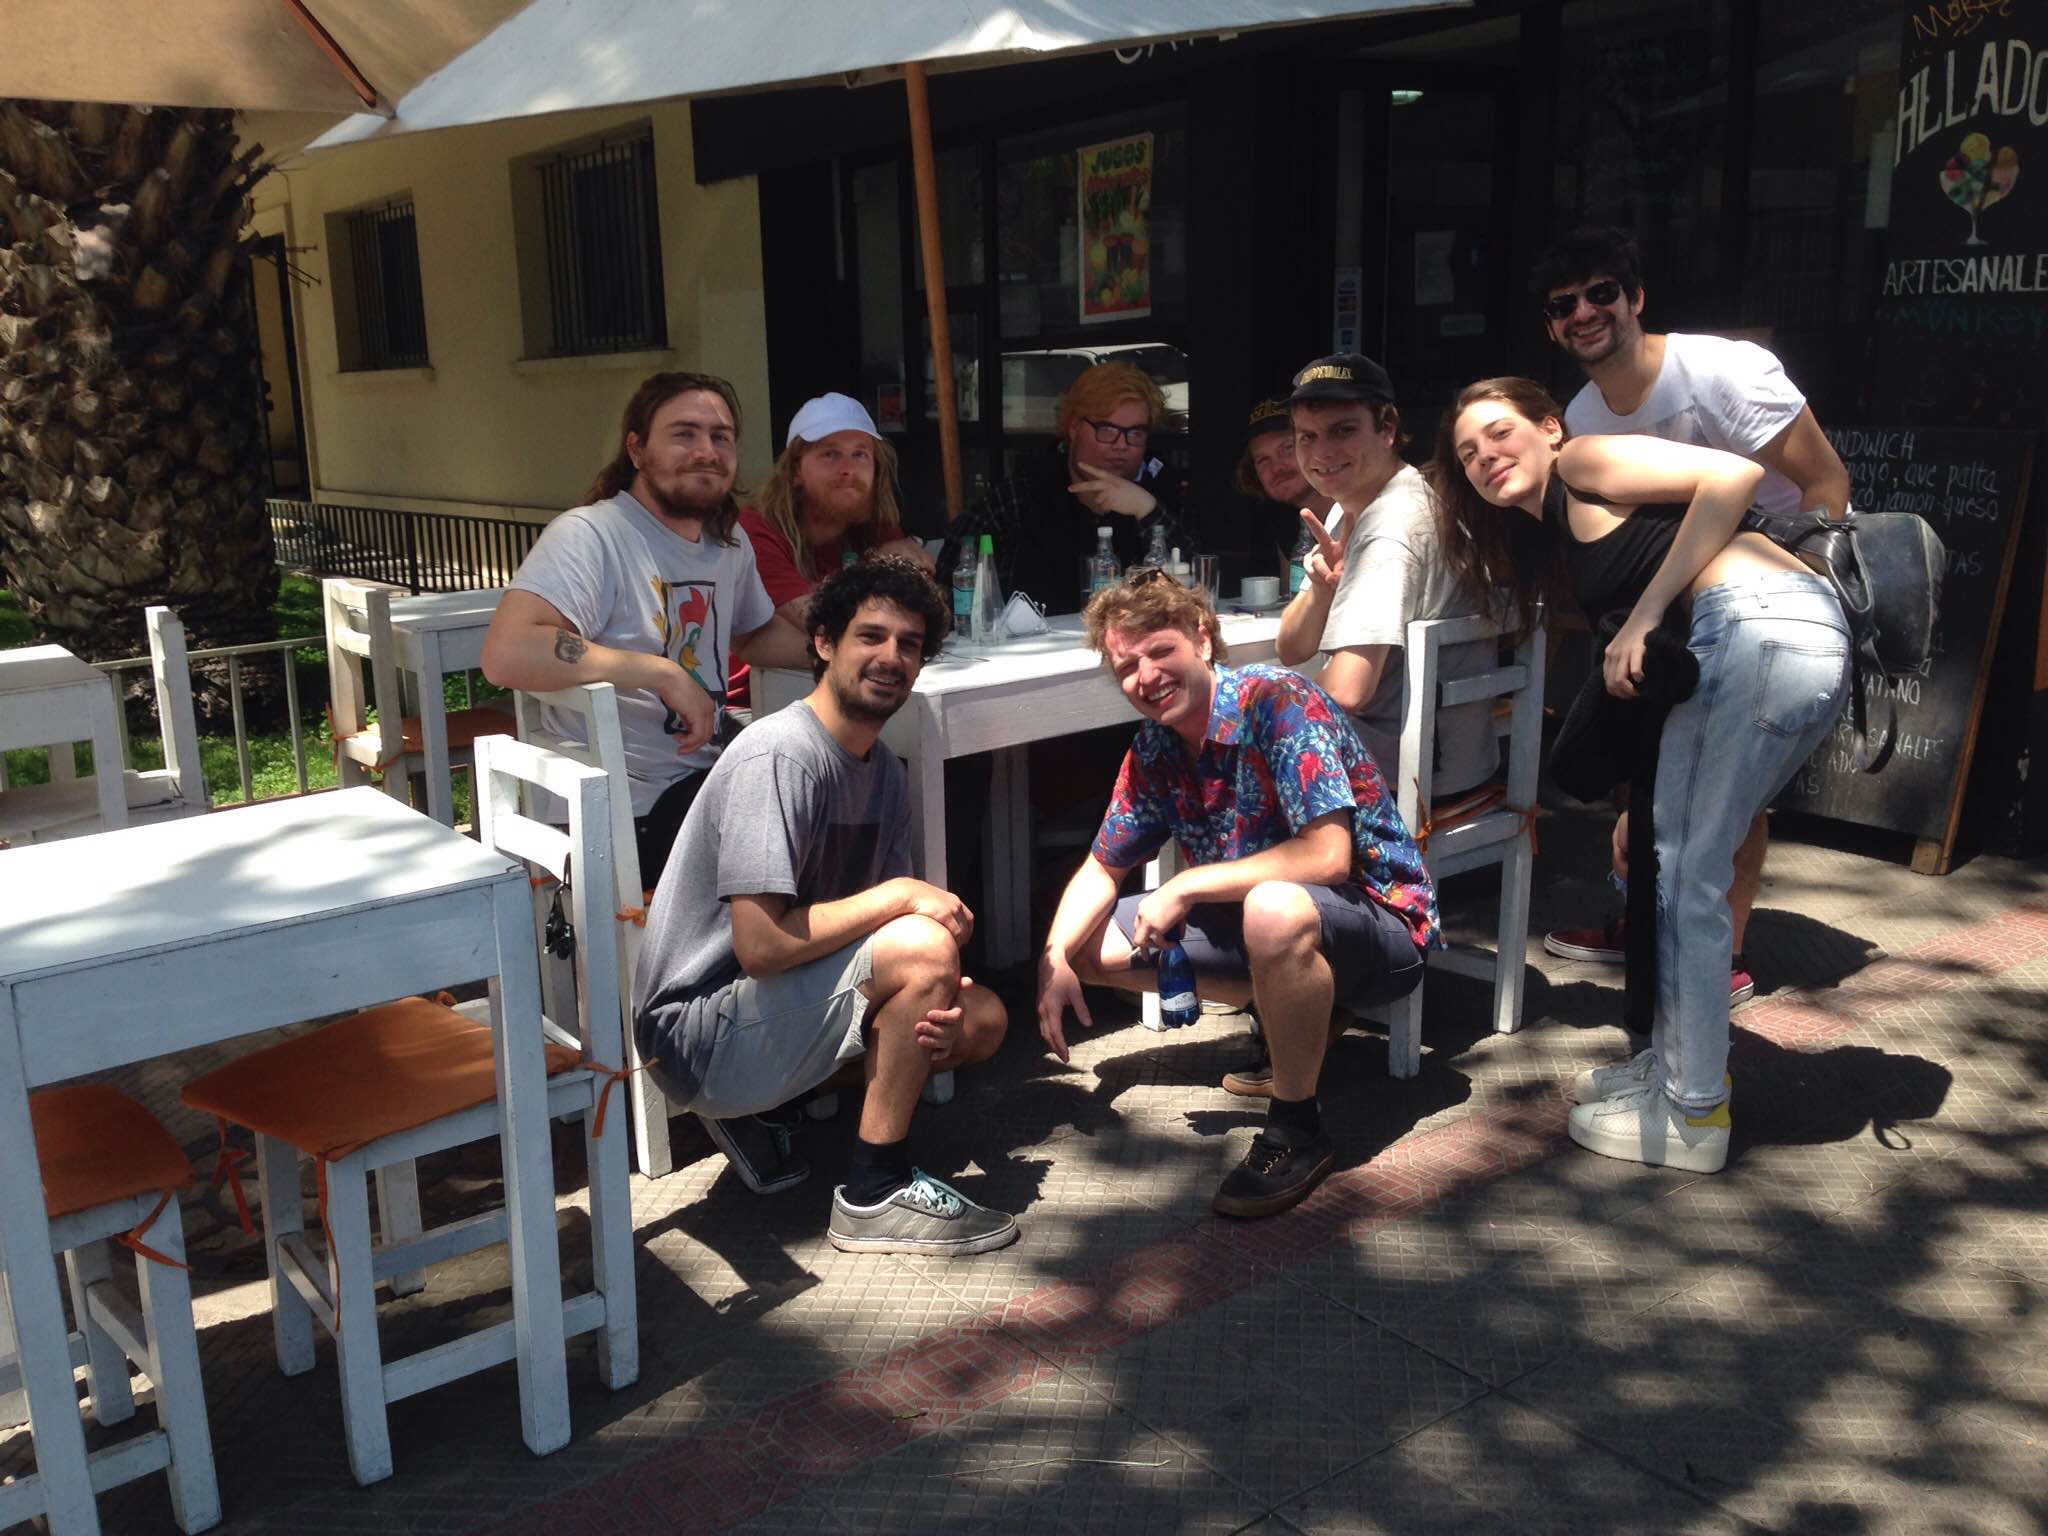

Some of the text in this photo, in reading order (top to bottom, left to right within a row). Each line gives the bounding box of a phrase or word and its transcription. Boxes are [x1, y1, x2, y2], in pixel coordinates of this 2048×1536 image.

[1091, 141, 1146, 175] JUGOS
[1882, 253, 2048, 296] ARTESANALE
[1826, 429, 1914, 460] NDWICH
[1945, 460, 1999, 497] palta
[1946, 549, 1983, 576] TAS
